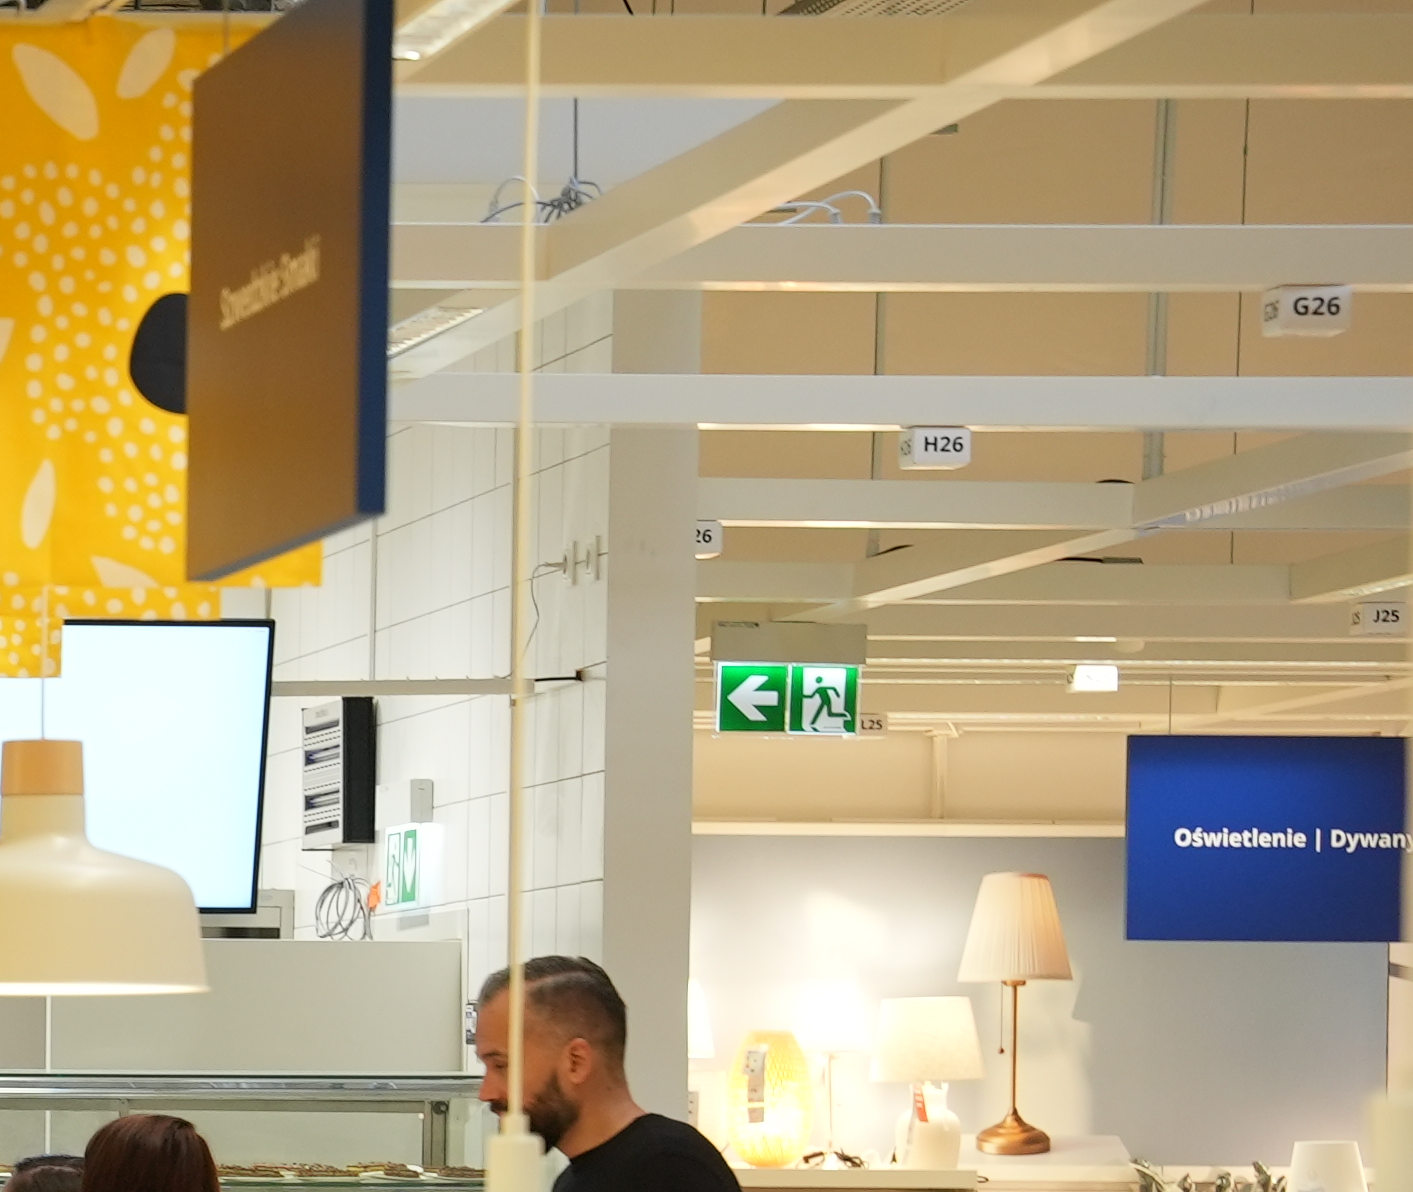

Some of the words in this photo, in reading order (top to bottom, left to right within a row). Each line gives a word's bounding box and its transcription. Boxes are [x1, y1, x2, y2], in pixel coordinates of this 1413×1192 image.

[1293, 296, 1341, 316] G26
[923, 436, 964, 453] H26
[695, 529, 713, 543] 26
[1373, 609, 1400, 624] J25
[860, 719, 883, 730] L25
[1174, 827, 1307, 848] Oświetlenie
